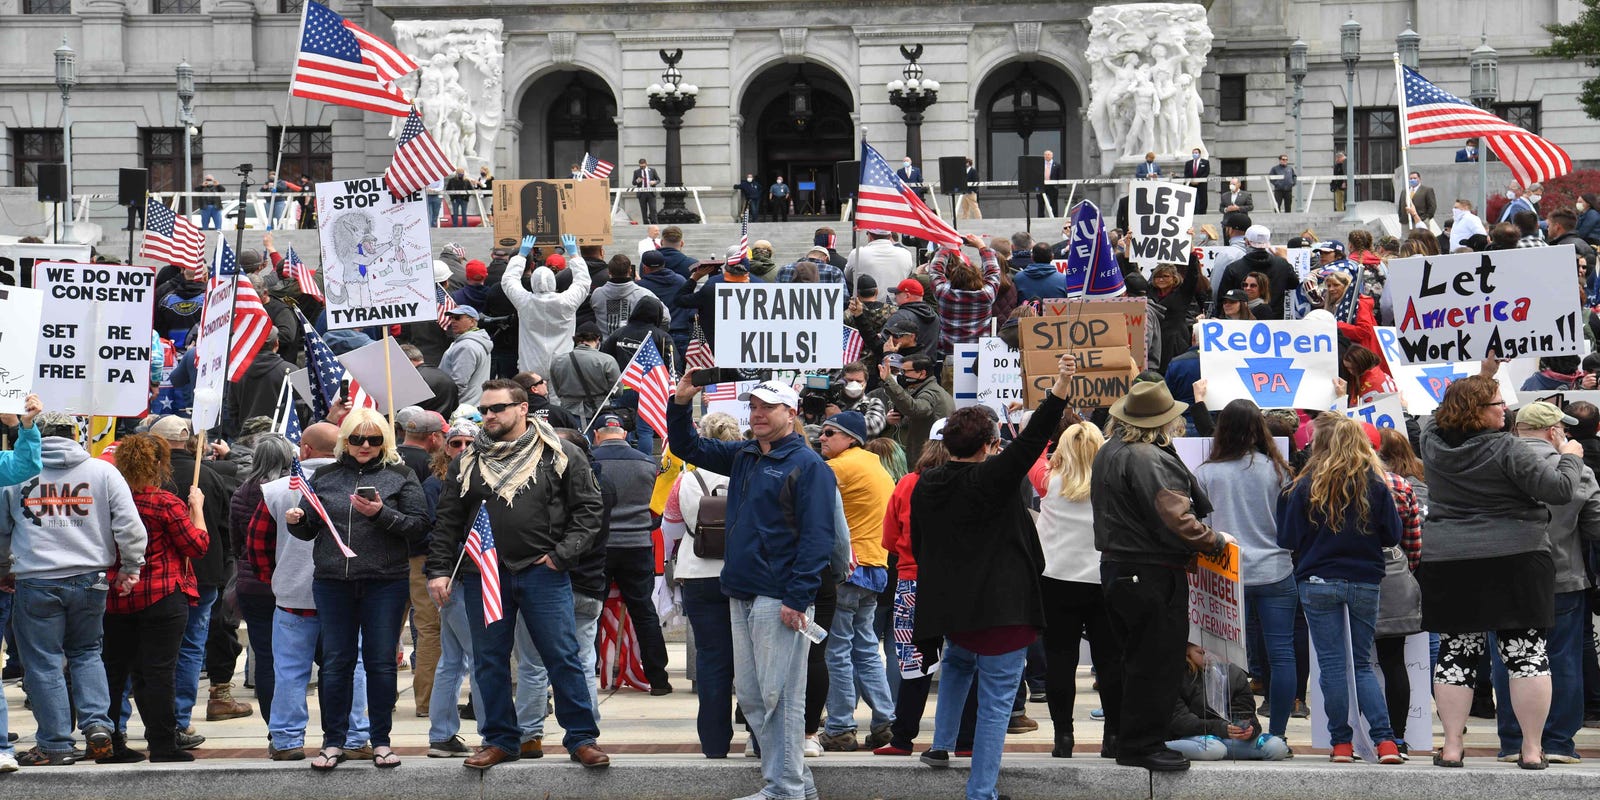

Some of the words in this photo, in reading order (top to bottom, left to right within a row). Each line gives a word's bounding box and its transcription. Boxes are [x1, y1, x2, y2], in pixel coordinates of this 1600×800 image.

[333, 194, 380, 210] STOP
[1136, 187, 1192, 217] LET
[1140, 215, 1179, 237] US
[1132, 237, 1189, 262] WORK
[47, 268, 74, 283] WE
[83, 269, 110, 284] DO
[117, 271, 154, 286] NOT
[1419, 254, 1496, 298] Let
[52, 284, 146, 302] CONSENT
[718, 288, 840, 320] TYRANNY
[331, 303, 418, 324] TYRANNY
[1400, 296, 1531, 333] America
[42, 324, 78, 338] SET
[108, 326, 132, 340] RE
[1033, 319, 1109, 350] STOP
[1202, 322, 1332, 358] ReOpen
[1398, 330, 1472, 362] Work
[1485, 311, 1576, 359] Again!!
[49, 344, 75, 359] US
[99, 346, 149, 361] OPEN
[741, 332, 817, 364] KILLS!
[39, 364, 86, 379] FREE
[994, 358, 1008, 368] DO
[108, 368, 135, 383] PA
[1252, 372, 1292, 393] PA
[1034, 375, 1129, 400] STDOWN
[36, 482, 89, 516] JMC
[1190, 590, 1205, 608] OR
[1209, 597, 1238, 624] BETTER
